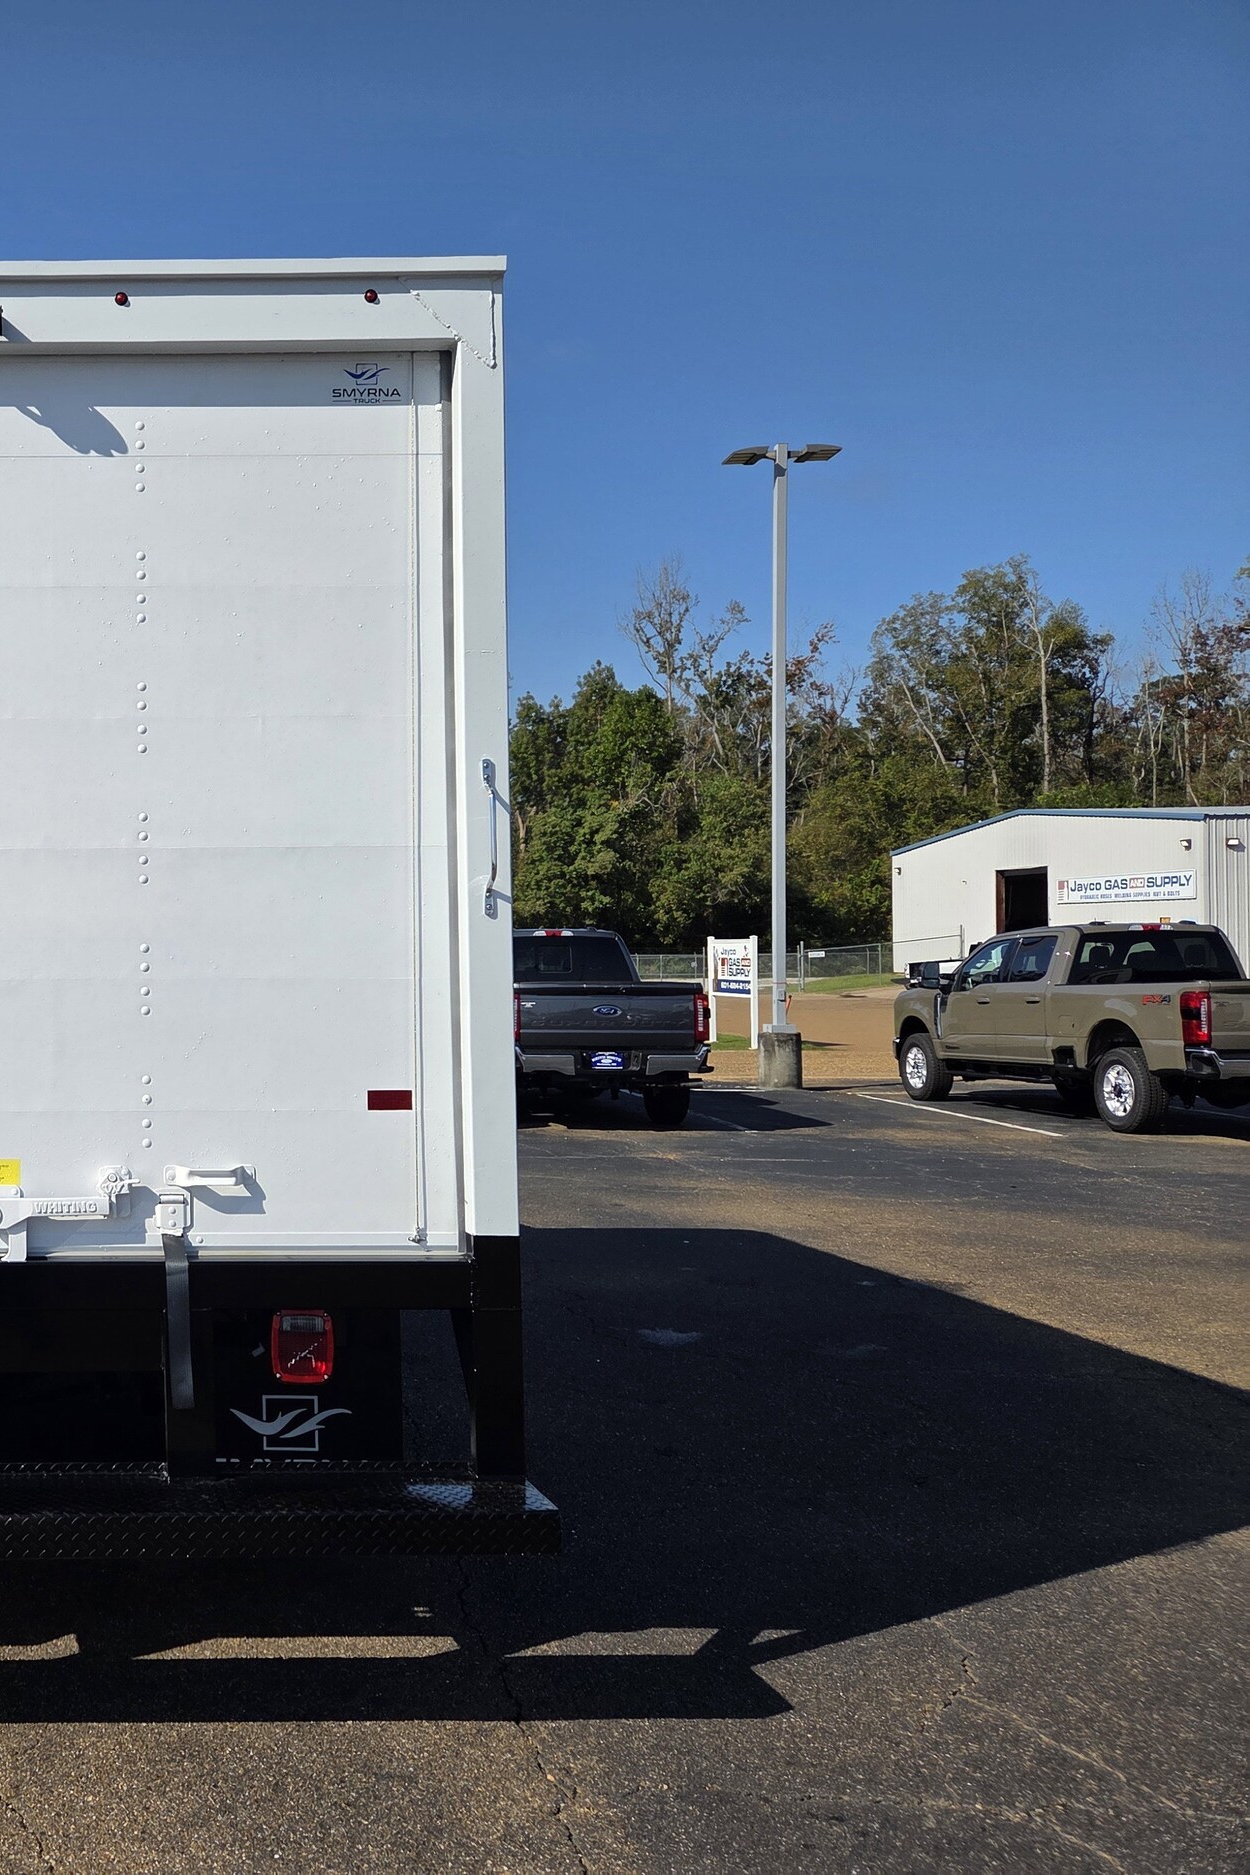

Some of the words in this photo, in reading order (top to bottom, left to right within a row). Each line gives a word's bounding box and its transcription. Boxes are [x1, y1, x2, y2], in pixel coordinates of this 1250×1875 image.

[332, 388, 401, 398] SMYRNA
[1070, 881, 1102, 894] Jayco
[1104, 879, 1128, 891] GAS
[1146, 875, 1192, 888] SUPPLY
[729, 958, 740, 967] GAS
[729, 968, 751, 977] SUPPLY
[1142, 995, 1171, 1005] FX4
[33, 1200, 98, 1214] WHITING
